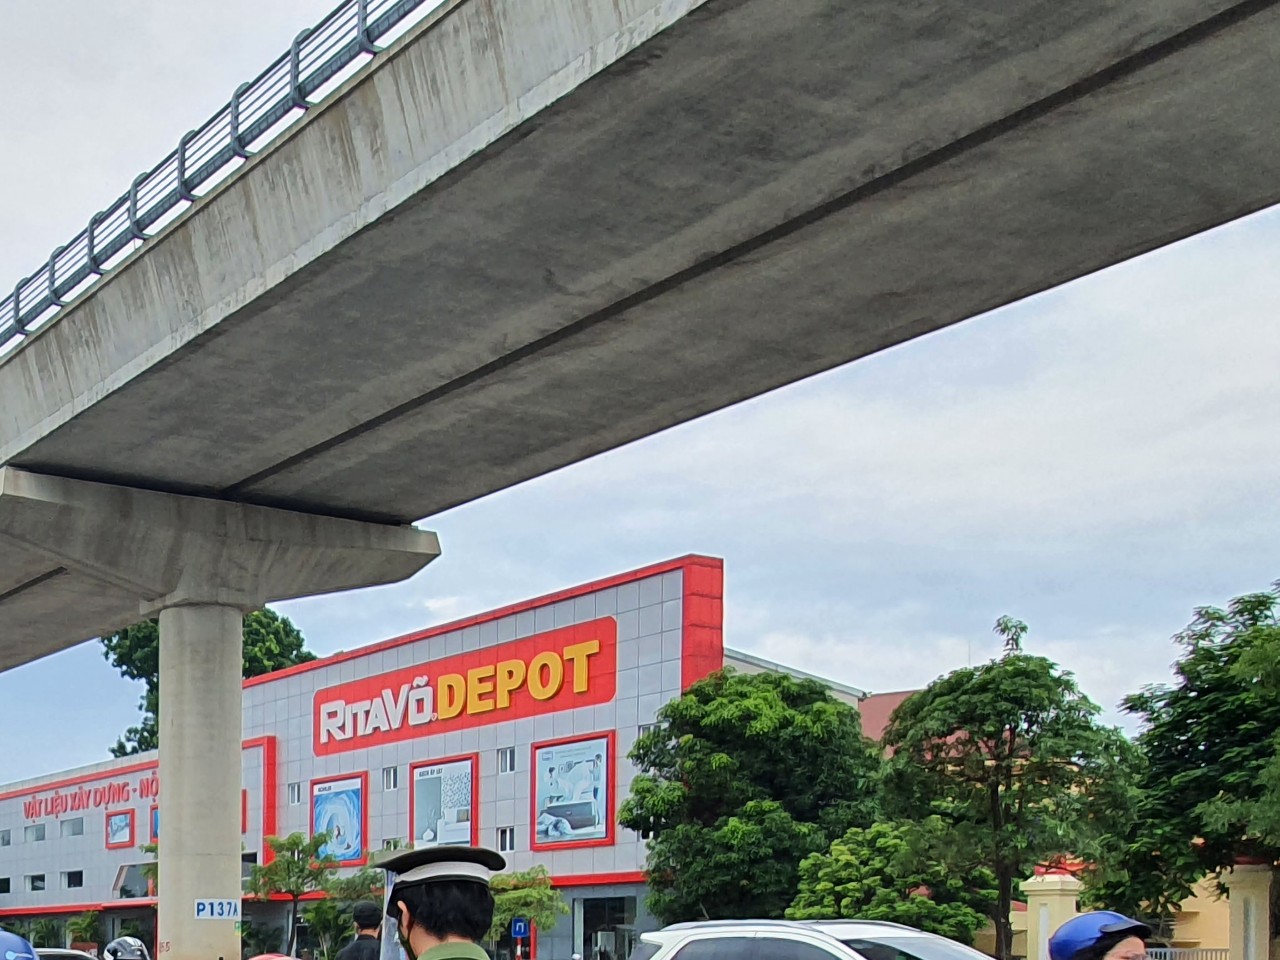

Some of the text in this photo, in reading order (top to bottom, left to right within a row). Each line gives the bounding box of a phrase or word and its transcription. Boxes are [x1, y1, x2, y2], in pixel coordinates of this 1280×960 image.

[437, 640, 600, 720] DEPOT
[23, 795, 43, 824] VẬT
[44, 790, 68, 819] LIỆU
[70, 786, 92, 812] XÂY
[93, 782, 130, 811] DỰNG
[140, 770, 159, 803] NỘ
[196, 902, 239, 917] P137A
